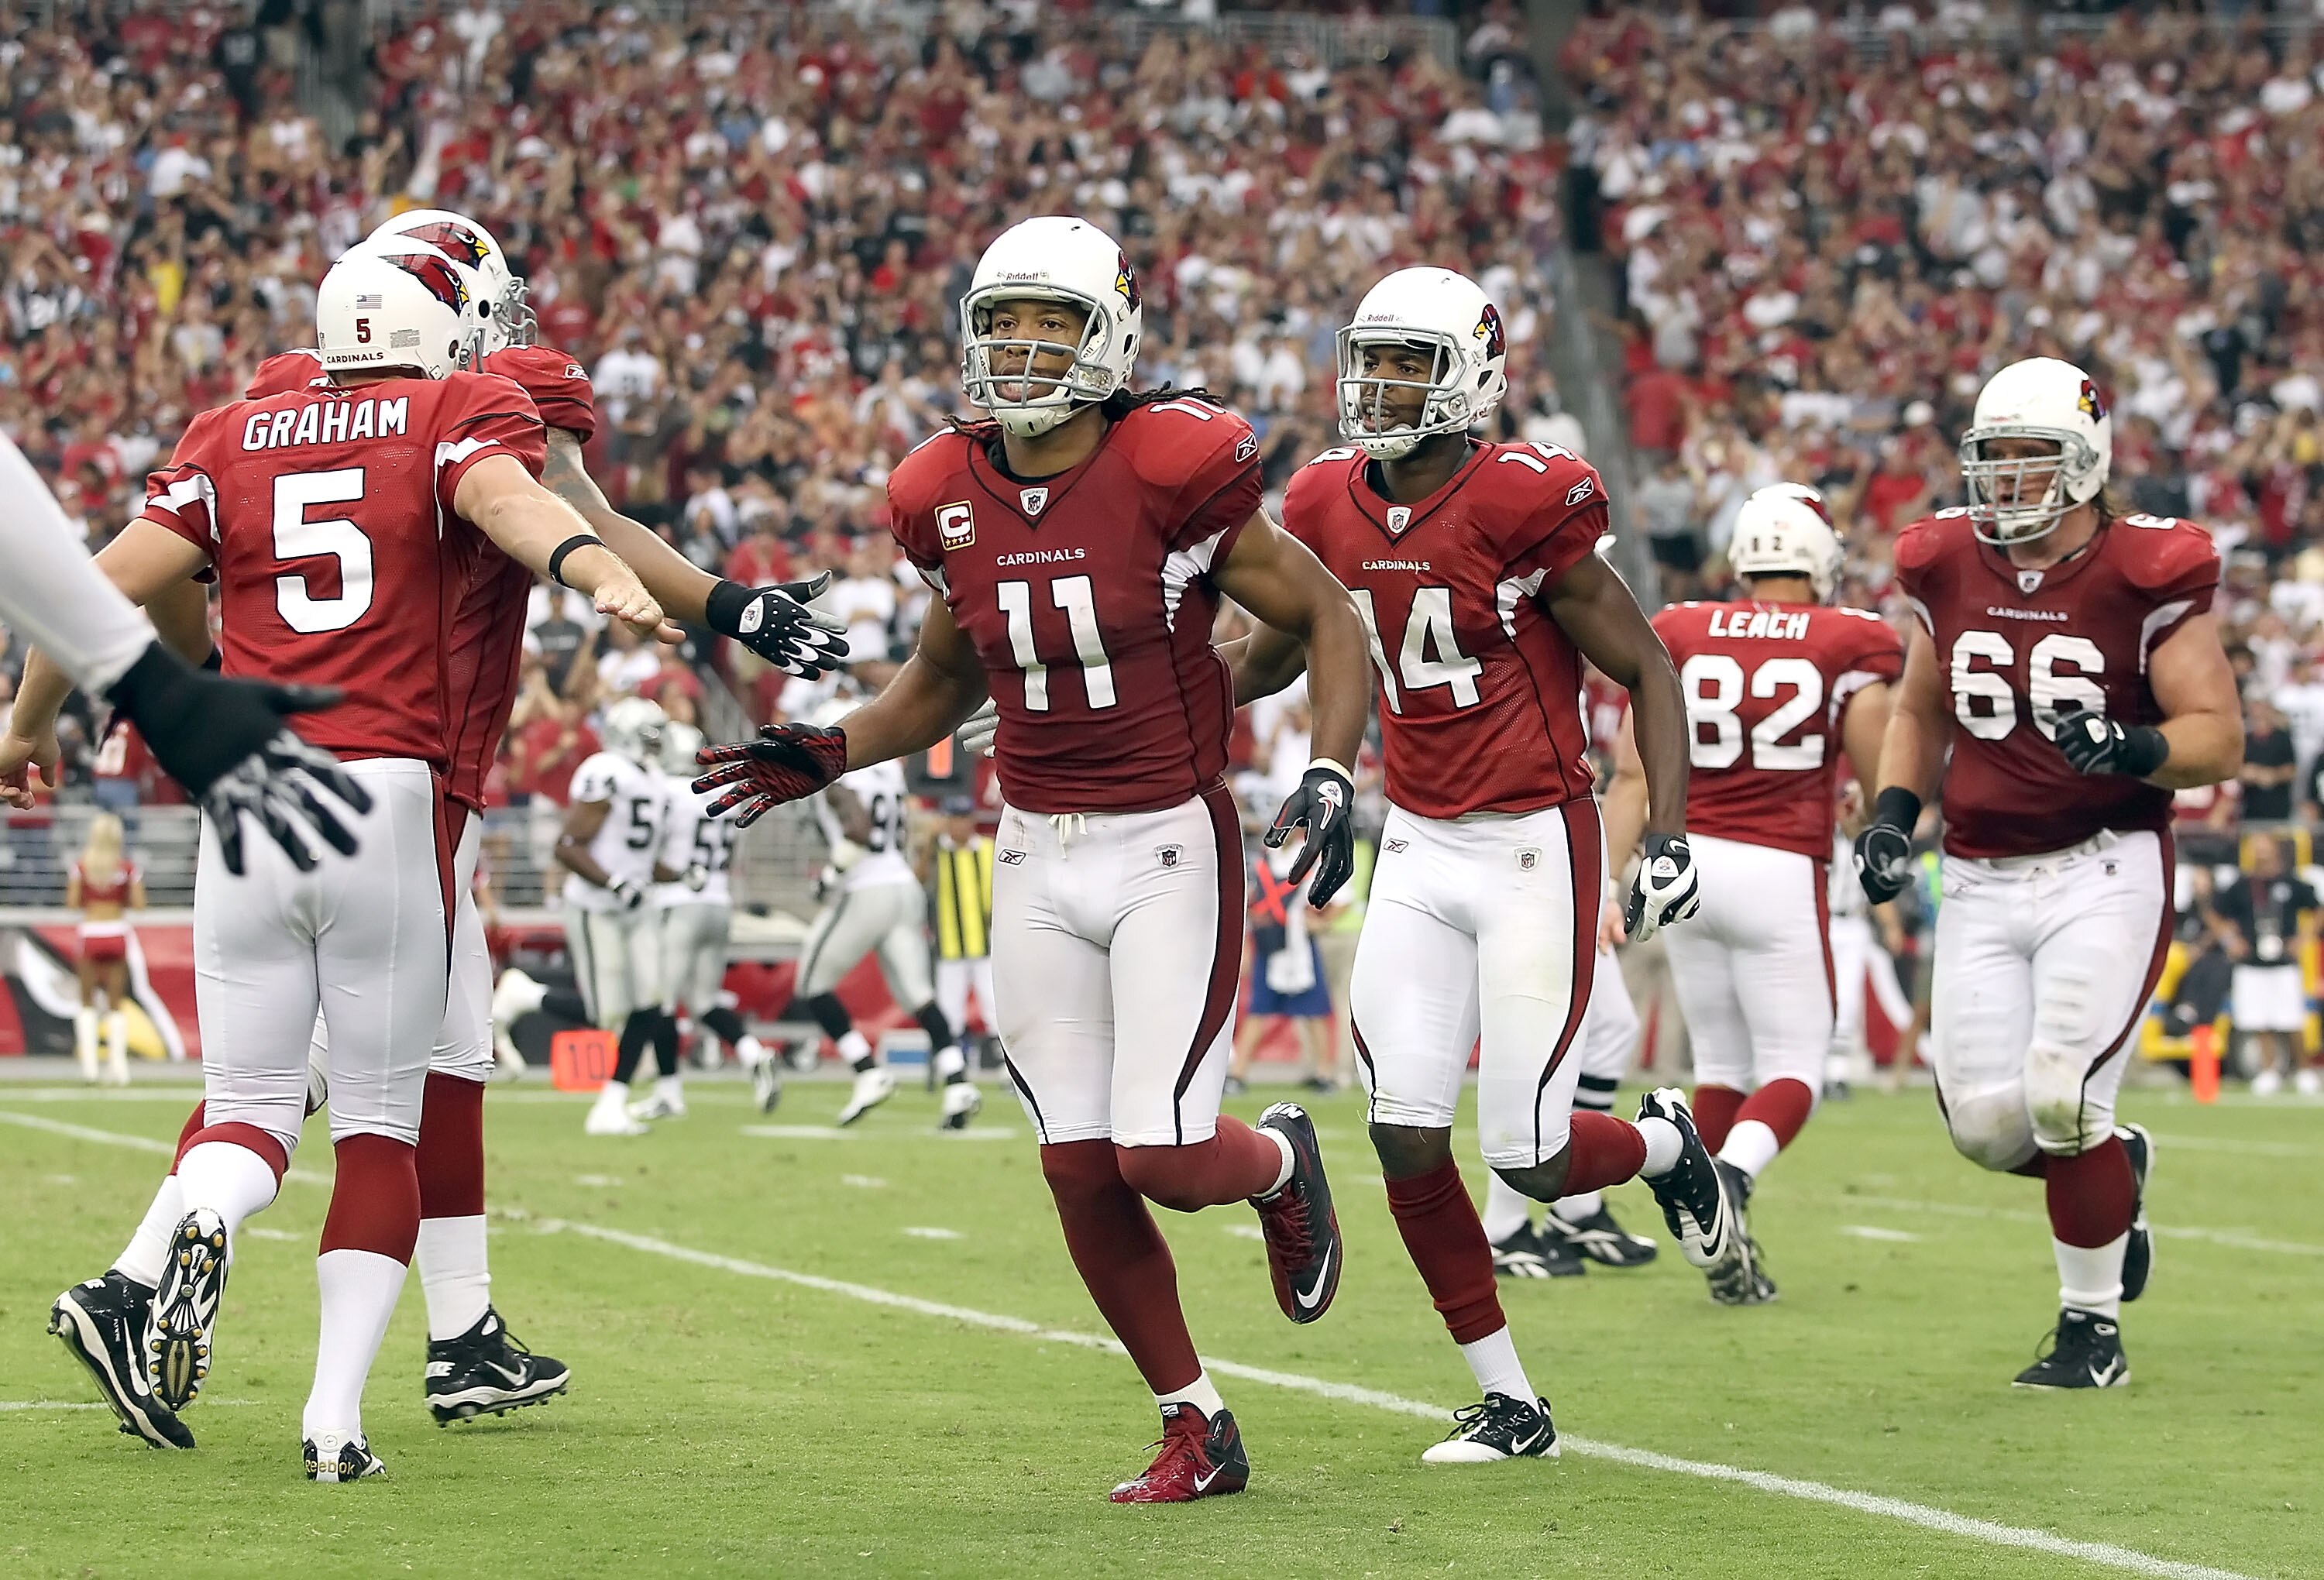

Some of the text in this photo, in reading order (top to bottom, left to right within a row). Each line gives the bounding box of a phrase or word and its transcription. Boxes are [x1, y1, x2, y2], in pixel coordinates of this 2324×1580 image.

[1006, 273, 1039, 281] Riddell
[356, 318, 371, 344] 5
[1367, 314, 1394, 322] Riddell
[326, 352, 384, 364] CARDINALS
[241, 396, 408, 451] GRAHAM
[940, 506, 971, 538] C
[273, 469, 373, 634] 5
[996, 548, 1085, 567] CARDINALS
[1362, 560, 1432, 572] CARDINALS
[1708, 610, 1810, 641] LEACH
[1986, 606, 2069, 622] CARDINALS
[997, 575, 1116, 711] 11
[1350, 586, 1483, 709] 14
[1950, 630, 2106, 743] 66
[1680, 654, 1825, 770] 82
[569, 1042, 606, 1080] 10
[305, 1459, 356, 1475] Reebok
